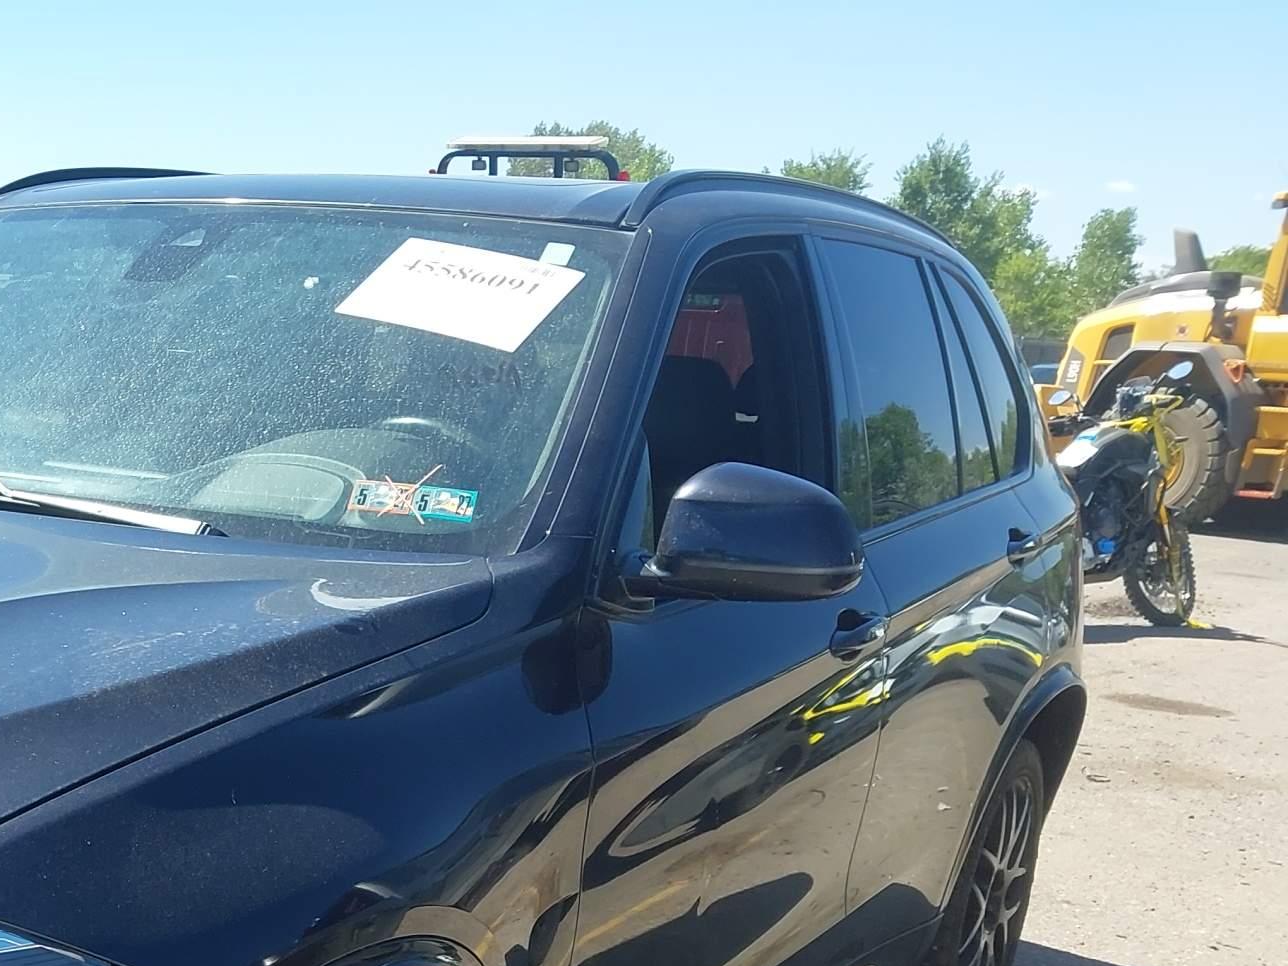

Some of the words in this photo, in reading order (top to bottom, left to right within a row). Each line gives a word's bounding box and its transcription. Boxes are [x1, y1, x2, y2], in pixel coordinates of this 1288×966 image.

[403, 257, 540, 294] 45586091
[356, 488, 368, 505] 5
[417, 494, 430, 512] 5
[456, 494, 472, 515] 27
